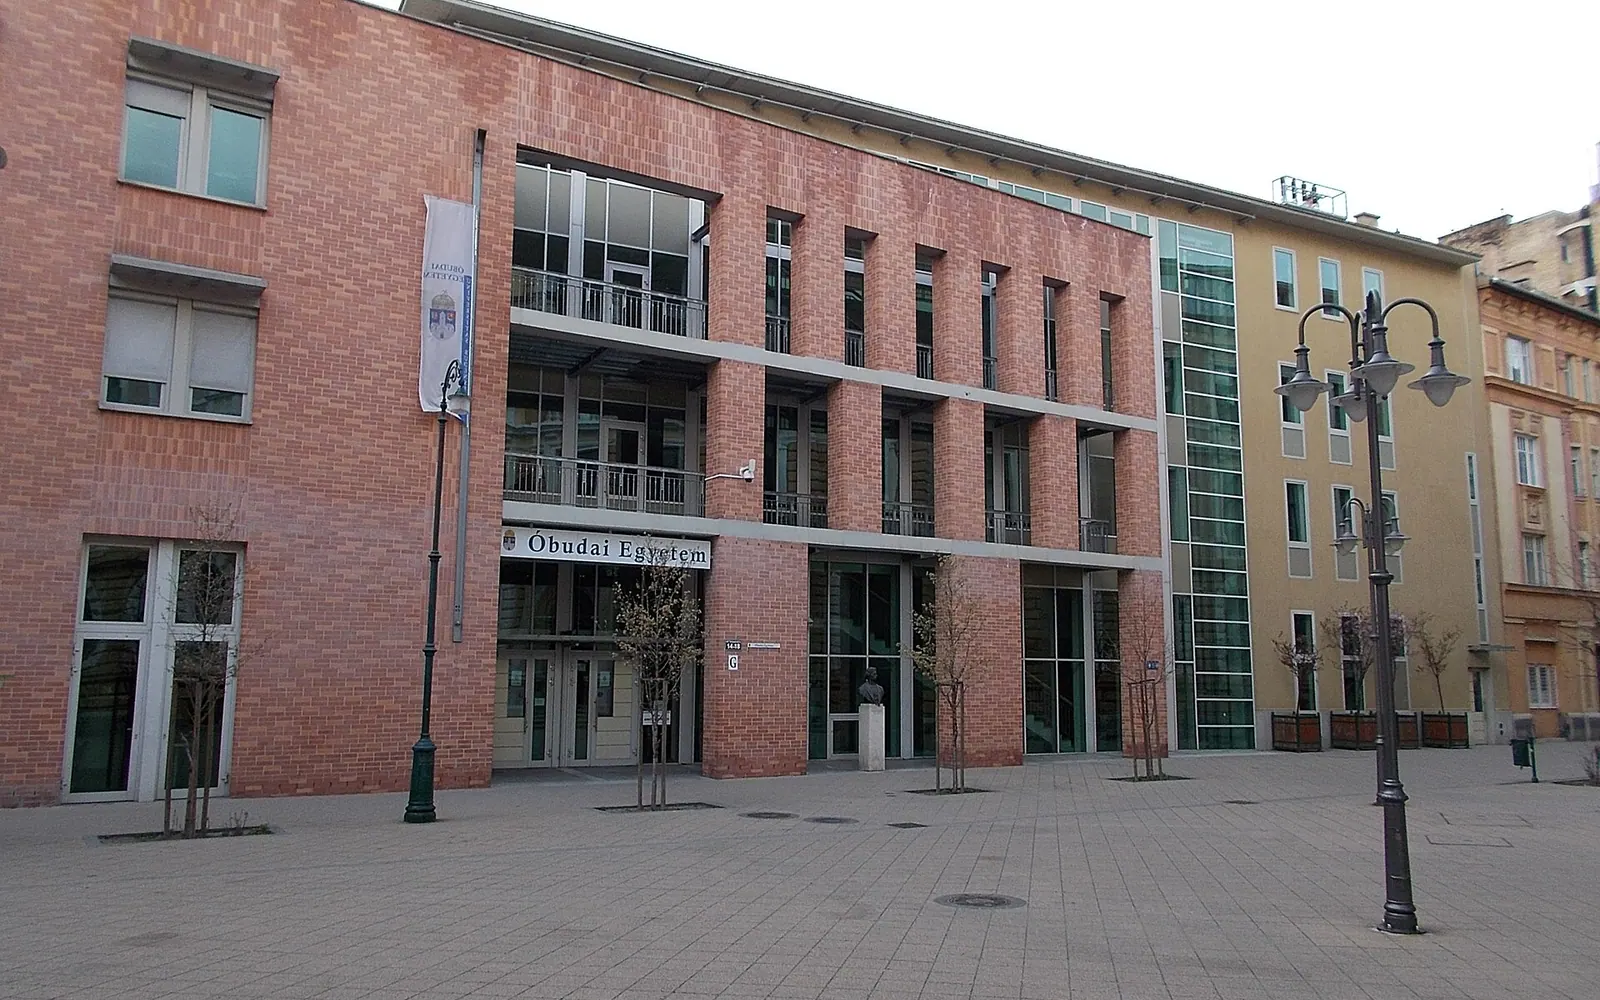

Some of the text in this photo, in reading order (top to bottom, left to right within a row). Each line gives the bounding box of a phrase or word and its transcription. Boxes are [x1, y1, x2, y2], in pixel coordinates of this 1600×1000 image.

[528, 530, 706, 563] Óbudai Egyetem
[730, 656, 737, 669] G
